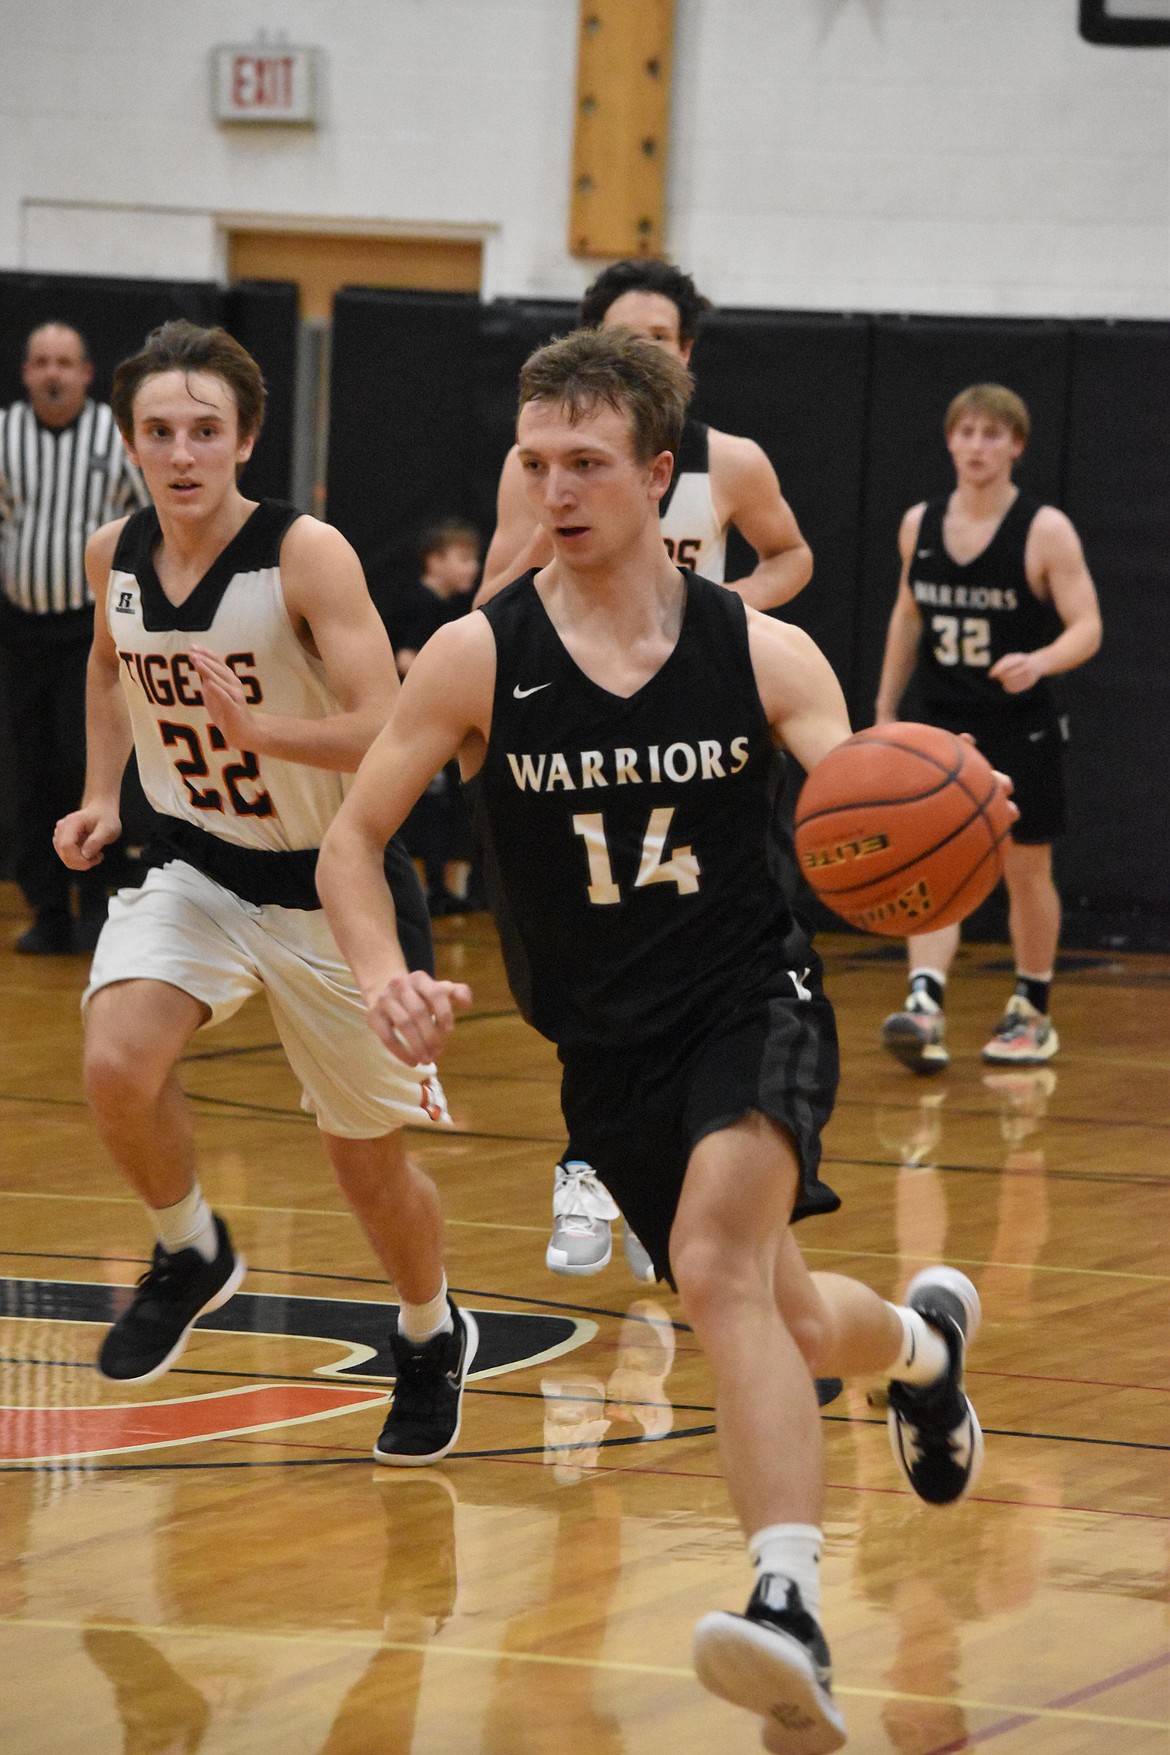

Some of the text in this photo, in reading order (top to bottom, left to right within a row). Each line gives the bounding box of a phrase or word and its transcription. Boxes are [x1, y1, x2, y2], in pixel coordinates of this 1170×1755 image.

[232, 56, 293, 107] EXIT
[914, 580, 1018, 611] WARRIORS
[931, 614, 991, 668] 32
[118, 651, 263, 706] TIGES
[157, 719, 277, 818] 22
[506, 736, 750, 792] WARRIORS
[572, 806, 701, 905] 14
[803, 833, 890, 869] ELITE
